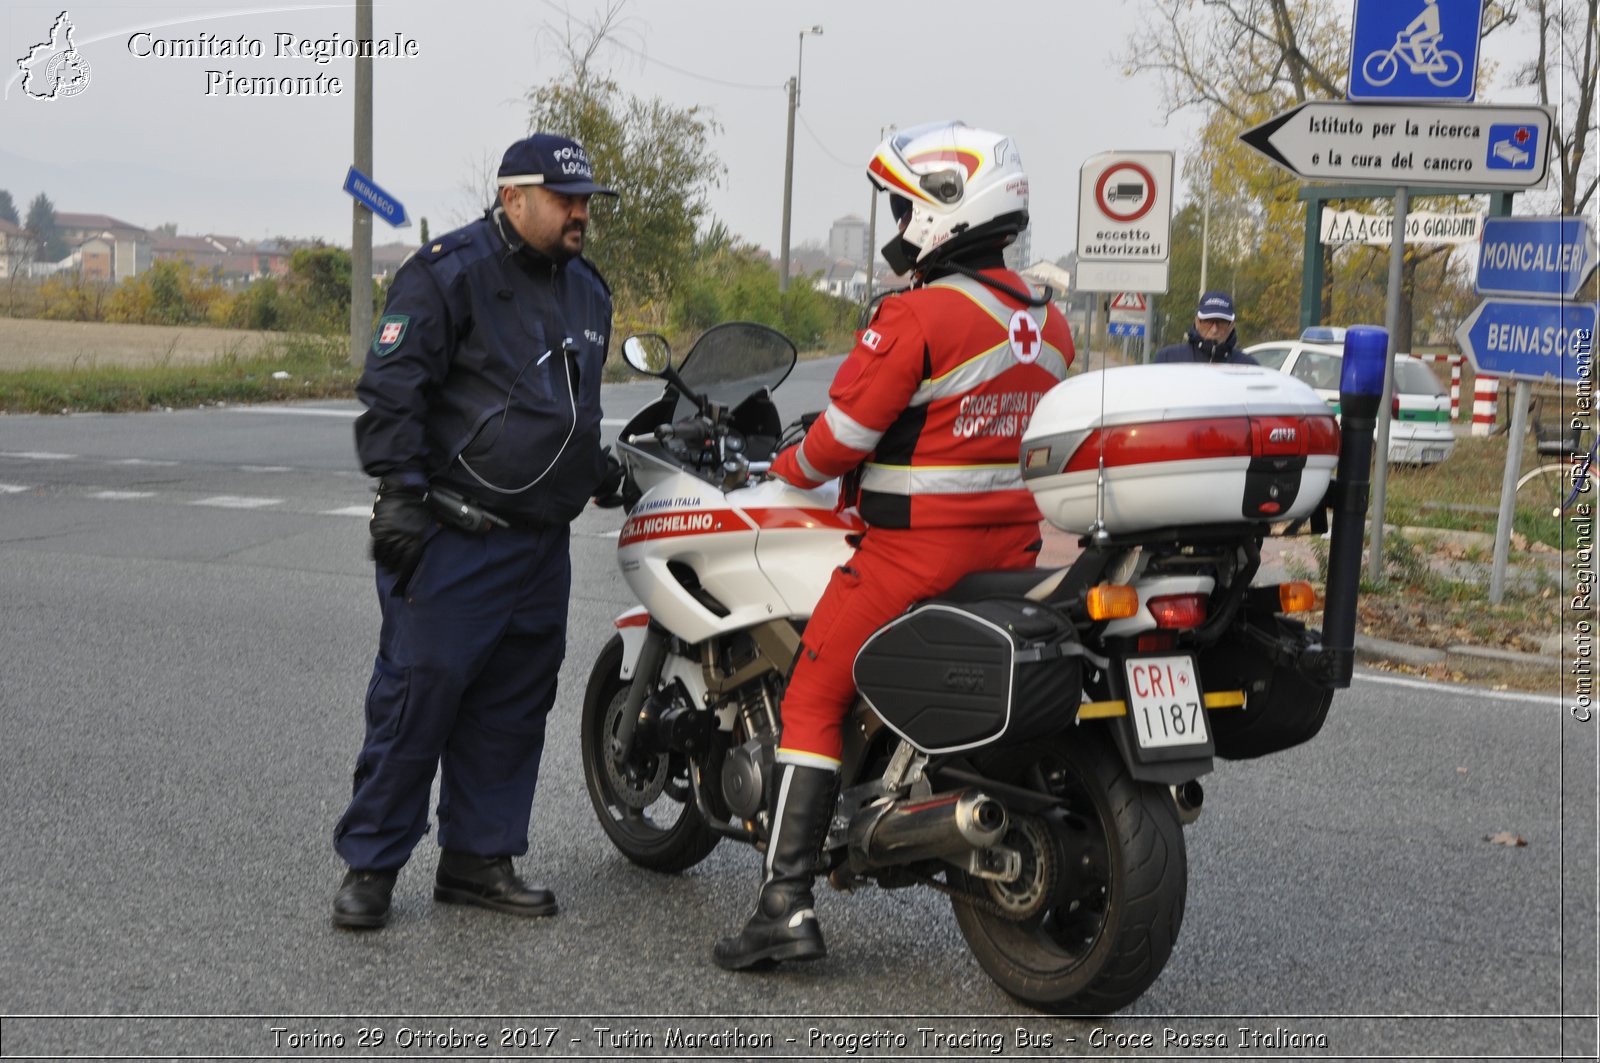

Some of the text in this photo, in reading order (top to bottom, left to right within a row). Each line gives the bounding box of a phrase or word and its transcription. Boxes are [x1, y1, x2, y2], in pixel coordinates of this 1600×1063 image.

[1309, 116, 1480, 139] Istituto per la ricerca
[1311, 150, 1473, 171] e la cura del cancro
[354, 178, 394, 216] BEINASCO
[1096, 228, 1151, 240] eccetto
[1423, 217, 1476, 239] GIARDINI
[1085, 243, 1161, 255] autorizzati
[1482, 241, 1584, 272] MONCALIERI
[960, 395, 998, 416] CROCE
[1000, 391, 1028, 414] ROSSA
[952, 414, 1018, 438] SOCCORSI
[646, 498, 673, 511] YAMAHA
[674, 497, 701, 508] ITALIA
[643, 513, 713, 535] NICHELINO
[943, 667, 985, 690] GIVI
[1132, 664, 1176, 699] CRI
[1142, 702, 1198, 740] 1187
